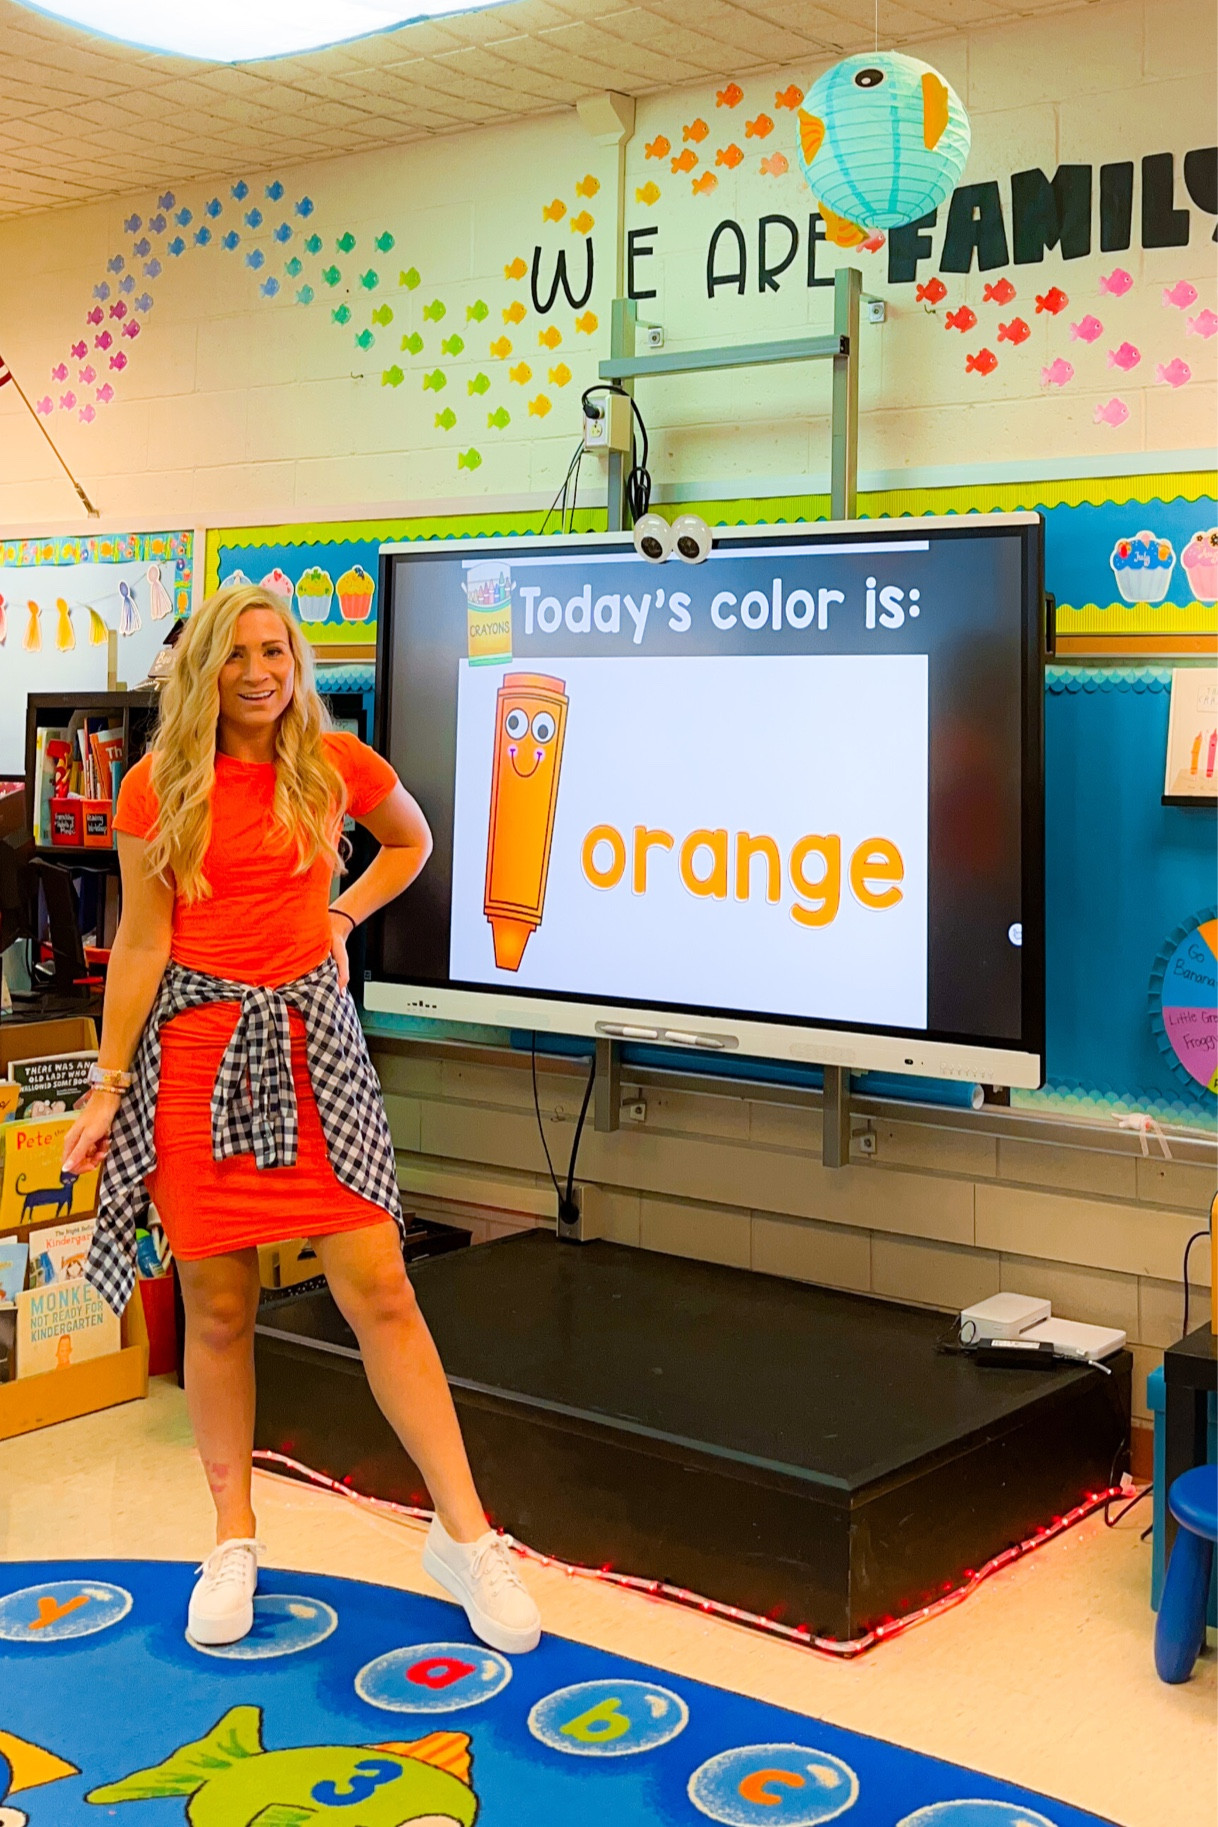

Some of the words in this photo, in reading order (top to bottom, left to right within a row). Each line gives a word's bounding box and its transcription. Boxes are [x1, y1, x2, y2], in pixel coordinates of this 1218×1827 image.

[531, 226, 659, 314] WE
[706, 213, 835, 299] ARE
[1133, 551, 1151, 567] July
[519, 583, 692, 645] Today's
[710, 578, 846, 631] color
[865, 576, 921, 630] is:
[469, 621, 511, 638] CRAYONS
[580, 824, 905, 930] orange
[1188, 943, 1205, 963] Go
[1173, 958, 1217, 987] Banana
[1168, 1012, 1197, 1026] Little
[25, 1064, 52, 1076] THERE
[54, 1062, 74, 1072] WAS
[77, 1061, 91, 1070] AN
[28, 1075, 44, 1084] OLD
[45, 1072, 66, 1081] LADY
[68, 1070, 87, 1078] WHO
[53, 1079, 71, 1088] SOME
[17, 1130, 52, 1150] Pete
[31, 1314, 49, 1329] NOT
[52, 1306, 82, 1324] READY
[85, 1301, 103, 1315] FOR
[31, 1313, 103, 1343] KINDERGARTEN
[406, 1656, 476, 1690] a
[559, 1697, 631, 1743] b
[311, 1758, 404, 1807] 3
[738, 1768, 806, 1806] c
